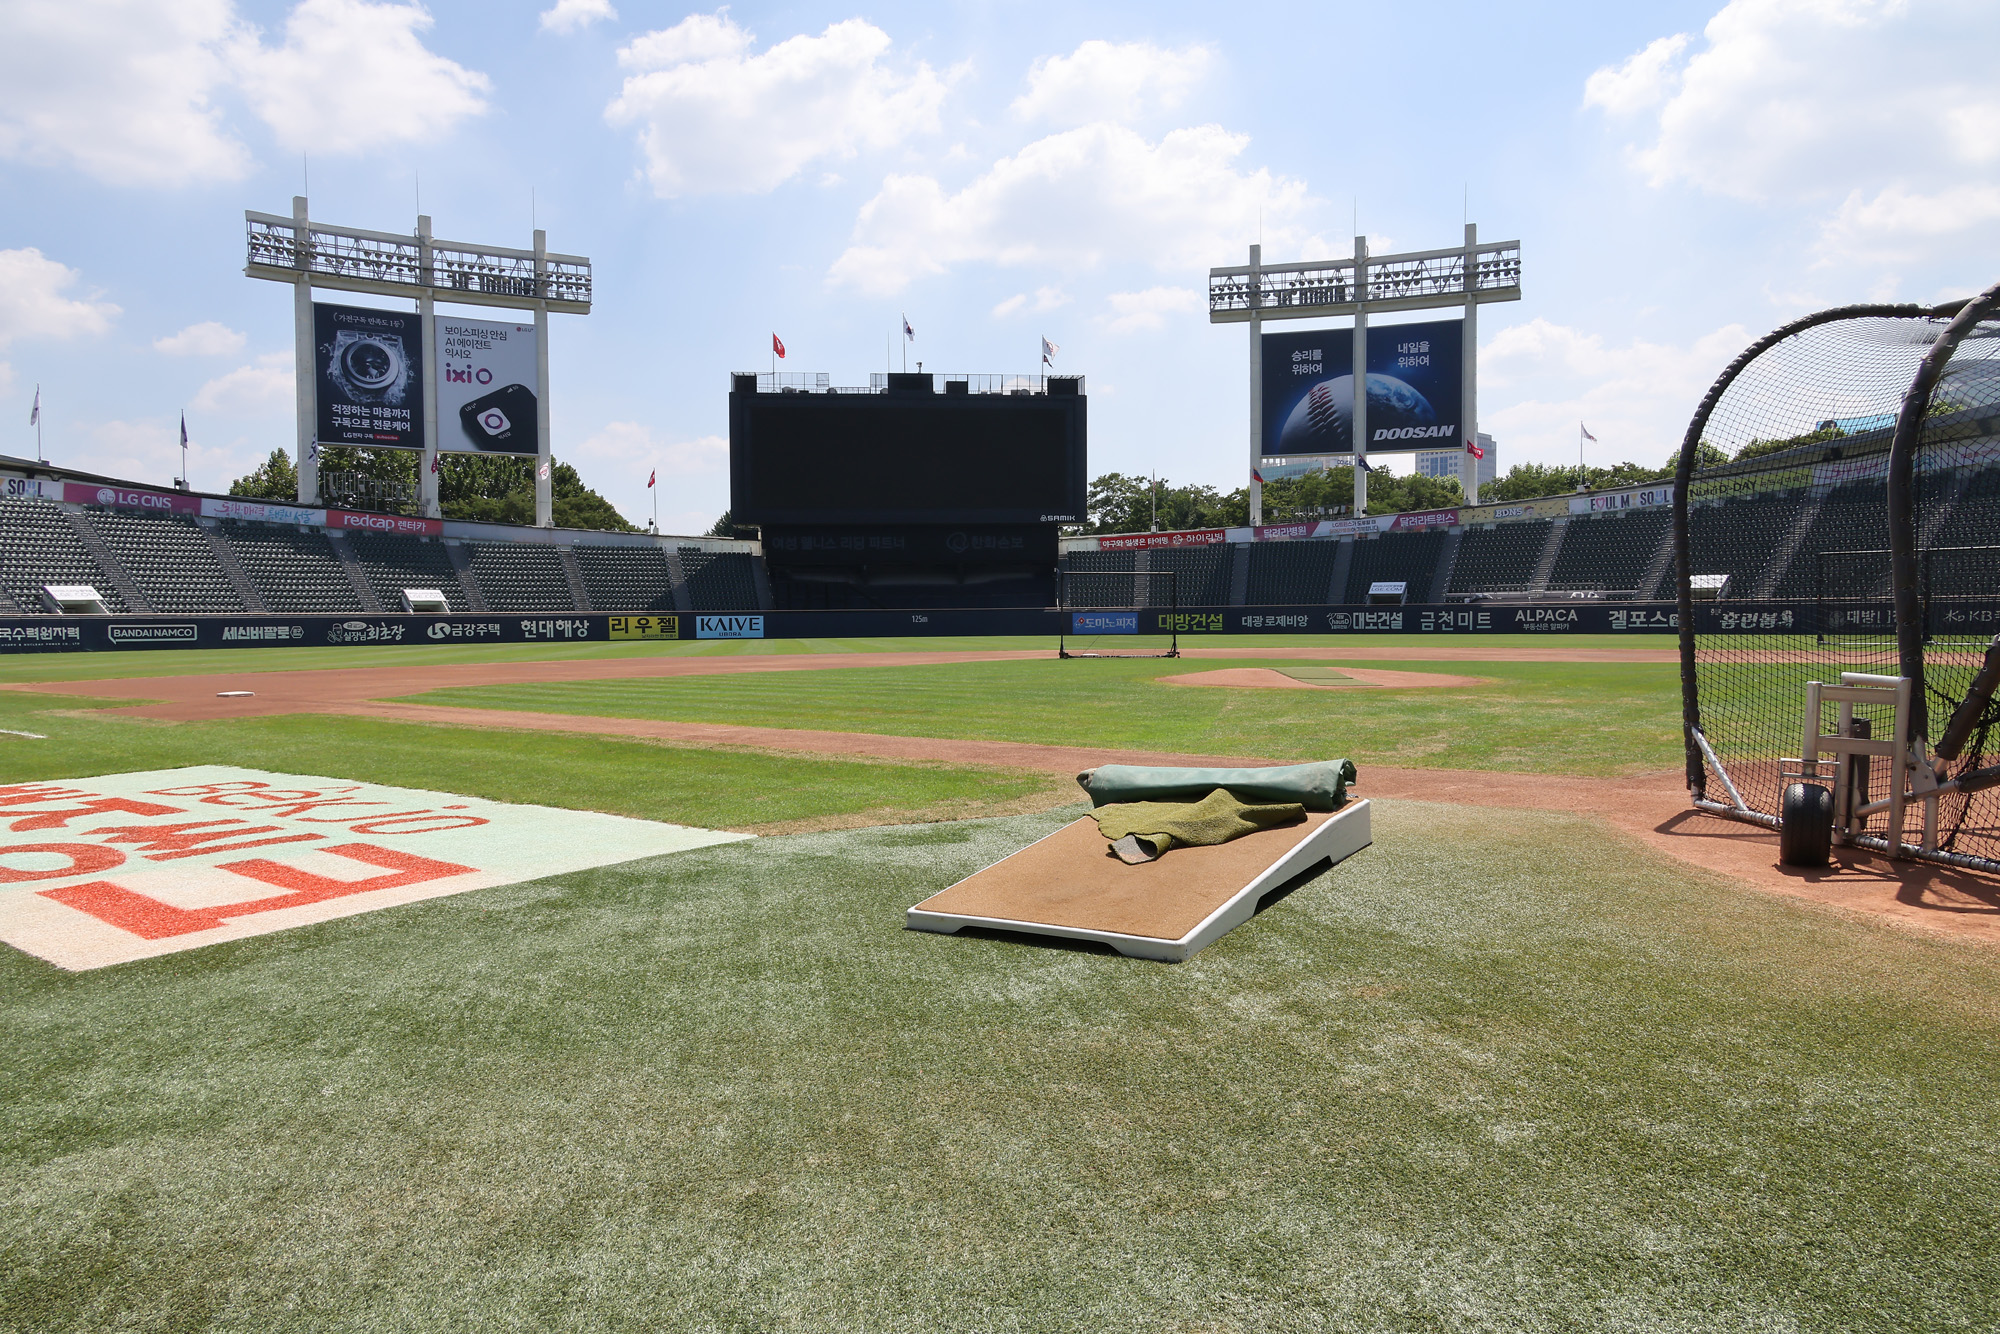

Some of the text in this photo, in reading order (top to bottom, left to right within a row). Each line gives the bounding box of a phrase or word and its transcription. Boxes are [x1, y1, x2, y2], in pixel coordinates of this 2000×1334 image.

[445, 326, 507, 341] 보이스피싱 안심
[446, 337, 492, 350] AI 에이전트
[1398, 341, 1430, 354] 내일을
[445, 348, 472, 359] 익시오
[1291, 349, 1322, 361] 승리를
[1398, 355, 1430, 368] 위하여
[1292, 363, 1322, 375] 위하여
[332, 404, 411, 420] 걱정하는 마음까지
[331, 416, 411, 432] 구독으로 전문케어
[1373, 425, 1455, 441] DOOSAN
[118, 493, 172, 509] LG CNS
[1495, 507, 1522, 518] BDNS
[344, 515, 427, 532] redcap 렌터카
[1399, 513, 1455, 527] 달려라트윈스
[1263, 525, 1306, 538] 달려라병원
[1102, 539, 1124, 548] 야구와
[1148, 537, 1169, 546] 타이밍
[911, 615, 929, 624] 125m
[1158, 613, 1224, 631] 대방건설
[1242, 615, 1309, 628] 대광 로제비앙
[1353, 612, 1403, 630] 대보건설
[1420, 610, 1492, 631] 금천미트
[1514, 609, 1579, 622] ALPACA
[520, 619, 590, 638] 현대해상
[611, 616, 677, 634] 리우젤
[700, 617, 761, 632] KAIVE
[1084, 617, 1137, 630] 도미노피자
[1523, 623, 1550, 631] 부동산은
[113, 628, 193, 637] BANDAI NAMCO
[222, 626, 290, 640] 세신버팔로
[344, 632, 367, 642] 실장님
[452, 623, 500, 638] 금강주택
